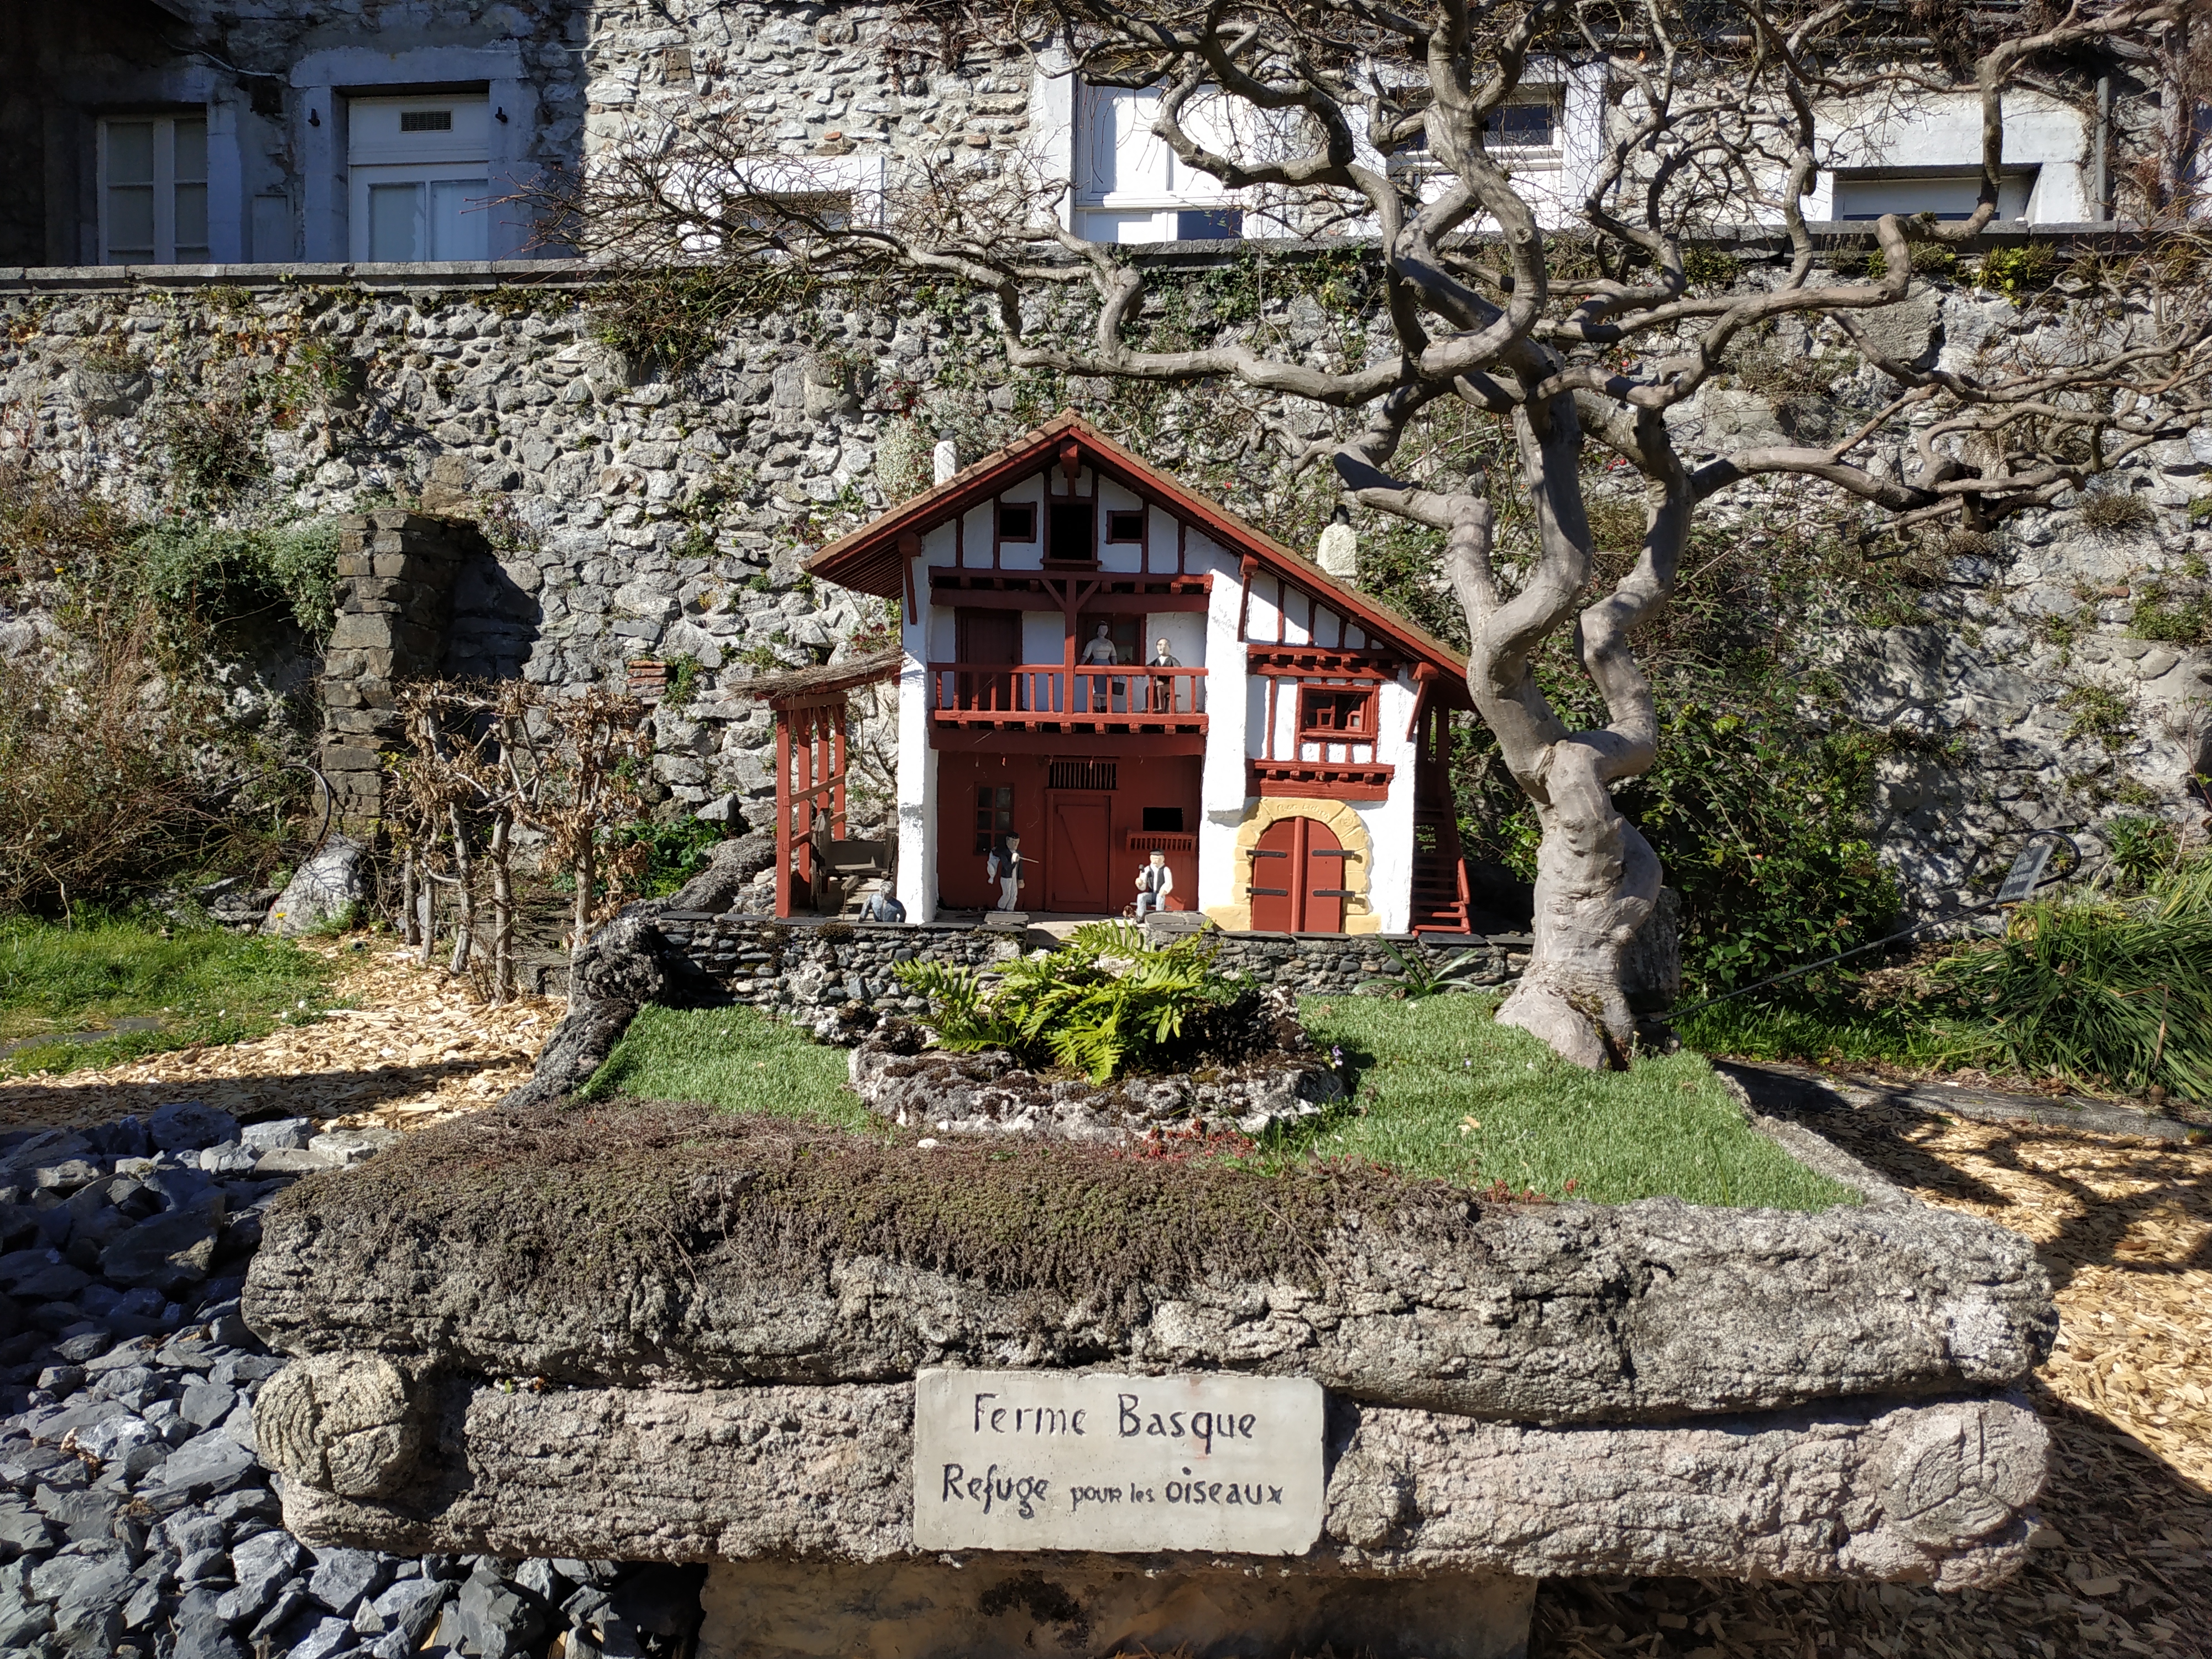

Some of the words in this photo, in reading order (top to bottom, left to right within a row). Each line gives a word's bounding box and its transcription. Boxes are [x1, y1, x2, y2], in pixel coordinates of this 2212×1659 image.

[974, 1392, 1087, 1436] Ferme
[1118, 1394, 1256, 1455] Basque
[942, 1463, 1048, 1520] Refuge
[1130, 1482, 1155, 1503] les
[1165, 1467, 1283, 1505] oiseaux
